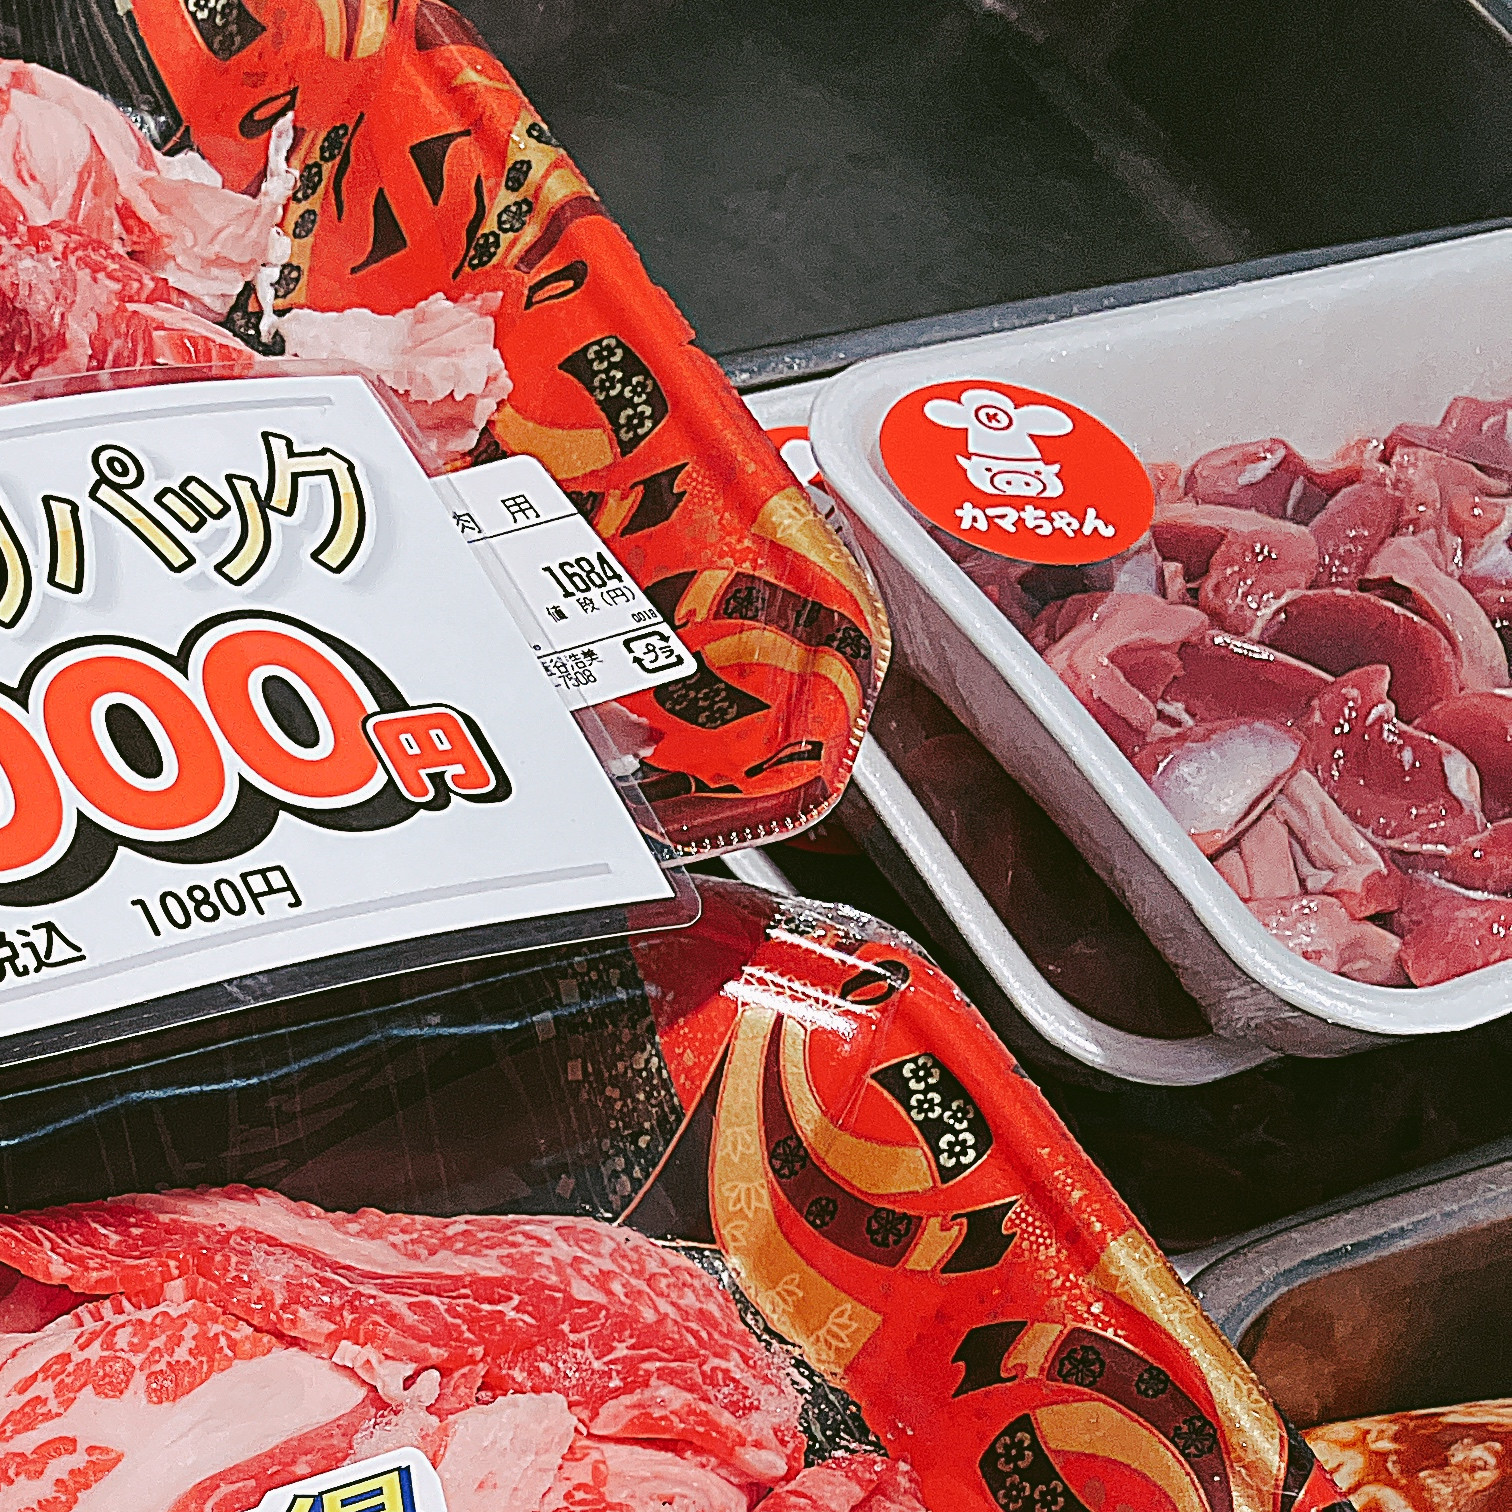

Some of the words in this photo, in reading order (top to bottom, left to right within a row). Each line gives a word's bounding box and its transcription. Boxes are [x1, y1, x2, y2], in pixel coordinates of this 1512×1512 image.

[954, 502, 1116, 537] カマちゃん
[542, 552, 623, 599] 1684
[130, 865, 303, 939] 1080円
